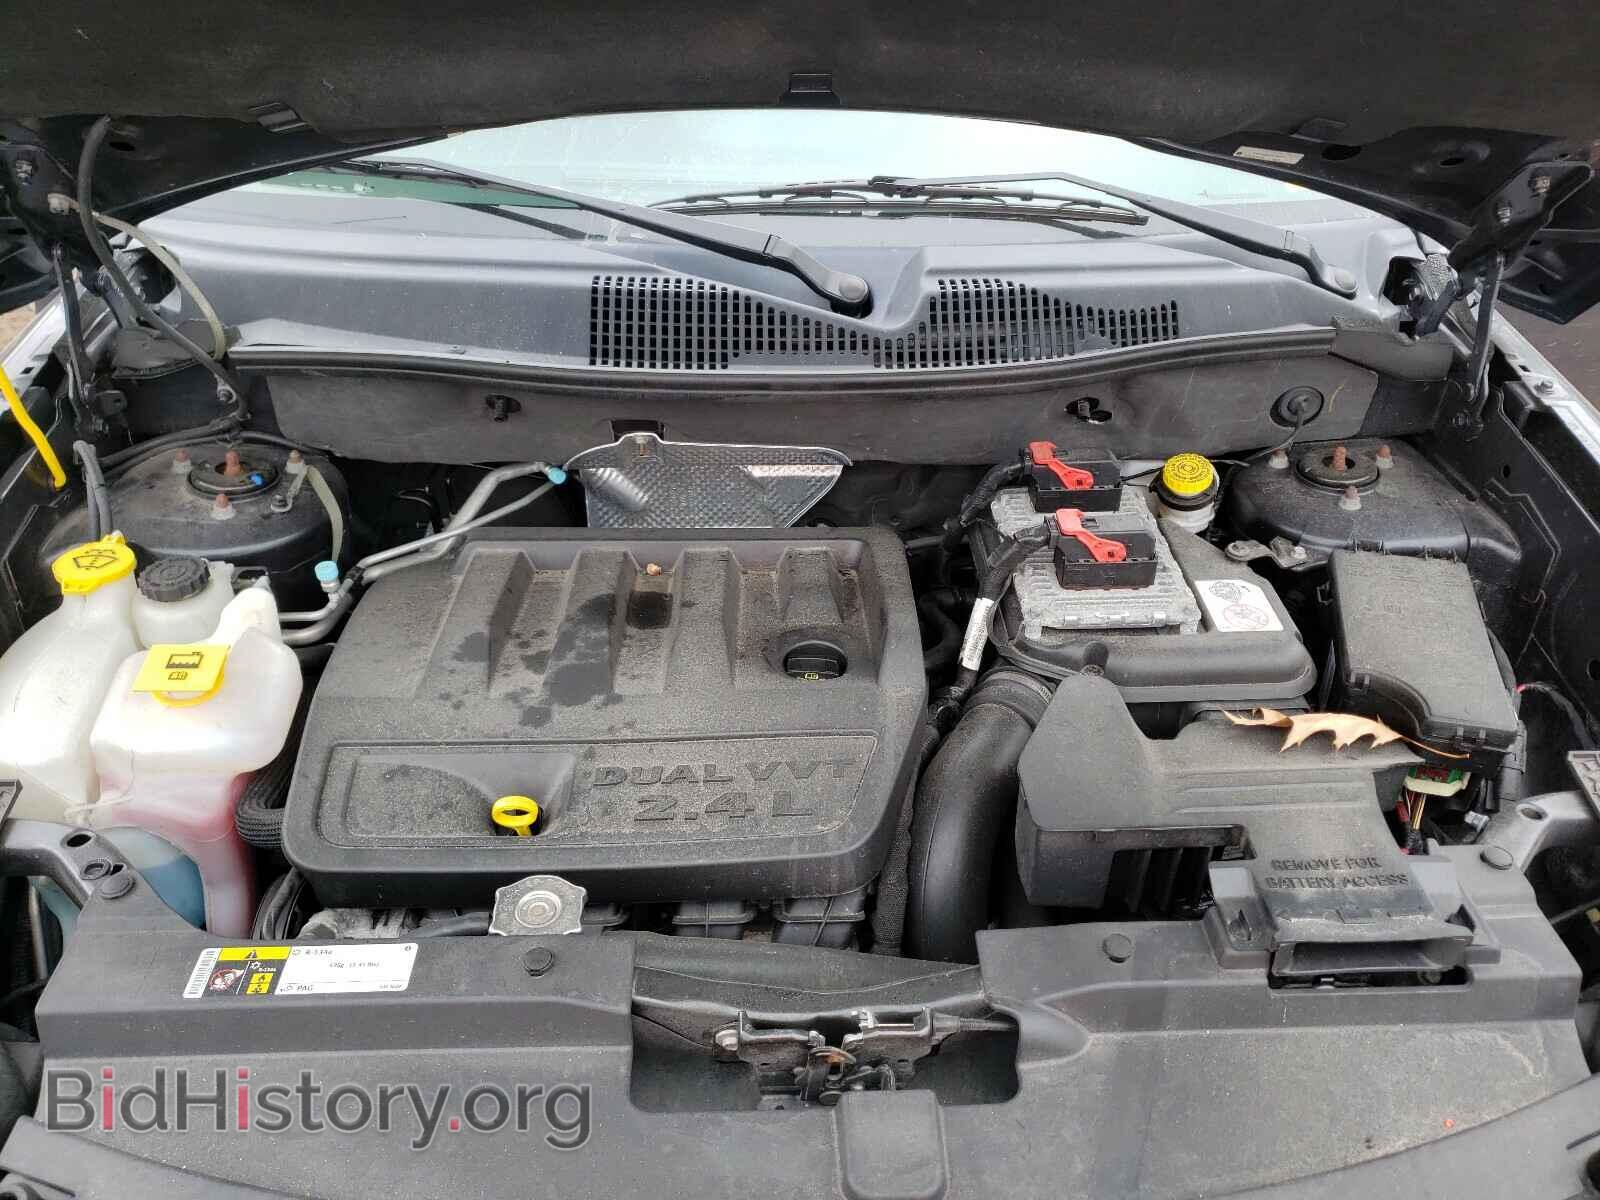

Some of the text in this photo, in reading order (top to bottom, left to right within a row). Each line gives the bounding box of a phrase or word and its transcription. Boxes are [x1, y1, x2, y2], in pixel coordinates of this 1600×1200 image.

[593, 760, 855, 786] DUAL VVT
[1270, 856, 1382, 871] REMOVE FOR
[1264, 874, 1409, 889] BATTERY ACCESS
